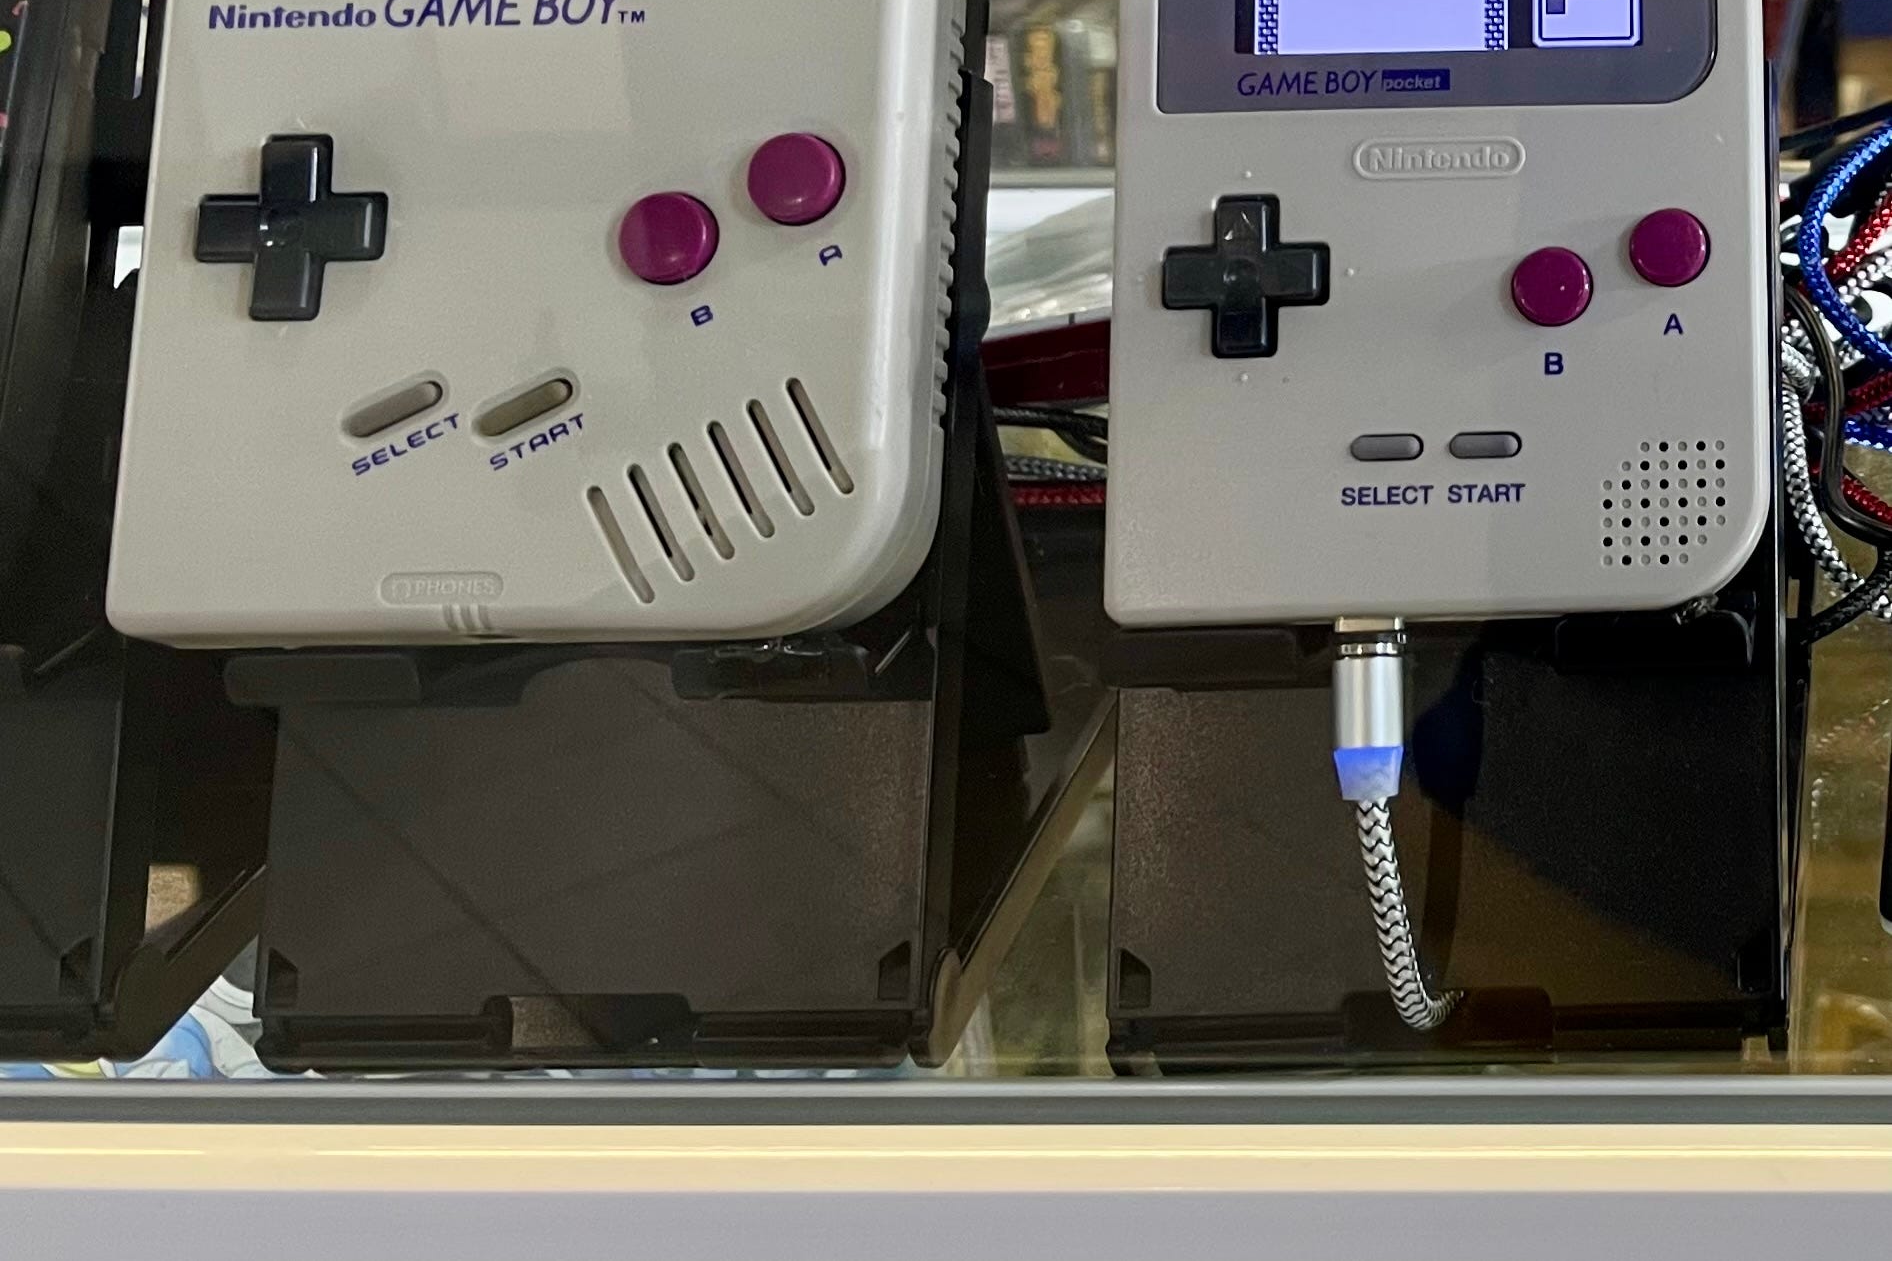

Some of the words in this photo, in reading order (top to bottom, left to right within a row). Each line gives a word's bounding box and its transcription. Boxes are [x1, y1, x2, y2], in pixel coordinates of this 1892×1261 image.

[208, 3, 377, 29] Nintendo
[1237, 72, 1318, 96] GAME
[1325, 70, 1378, 95] BOY
[1383, 74, 1442, 91] pocket
[1369, 146, 1511, 173] Nintendo
[818, 244, 843, 267] A
[690, 304, 714, 327] B
[1663, 313, 1684, 336] A
[1544, 352, 1565, 375] B
[351, 413, 459, 477] SELECT
[489, 413, 584, 472] START
[1341, 485, 1434, 506] SELECT
[1447, 483, 1526, 504] START
